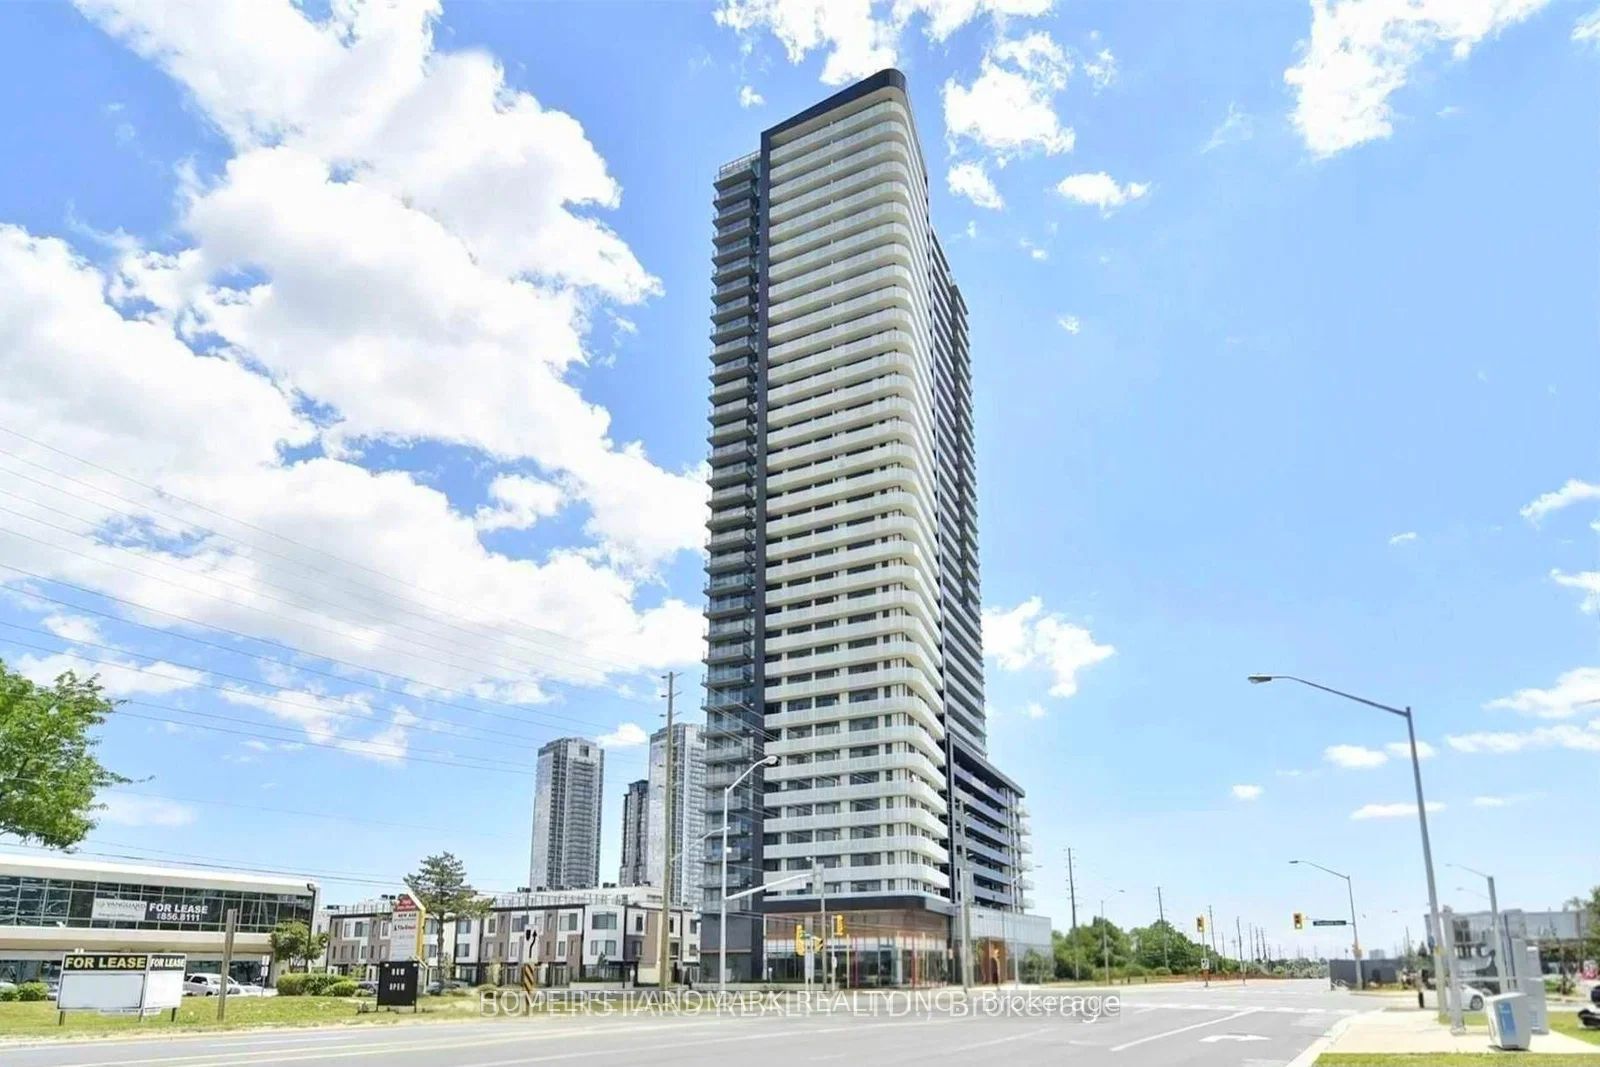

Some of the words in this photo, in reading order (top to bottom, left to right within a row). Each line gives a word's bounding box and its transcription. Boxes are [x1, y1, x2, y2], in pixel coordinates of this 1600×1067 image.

[149, 902, 172, 912] FOR
[174, 904, 209, 914] LEASE
[64, 957, 95, 969] FOR
[98, 957, 147, 969] LEASE
[151, 957, 165, 967] FOR
[165, 958, 185, 968] LEASE
